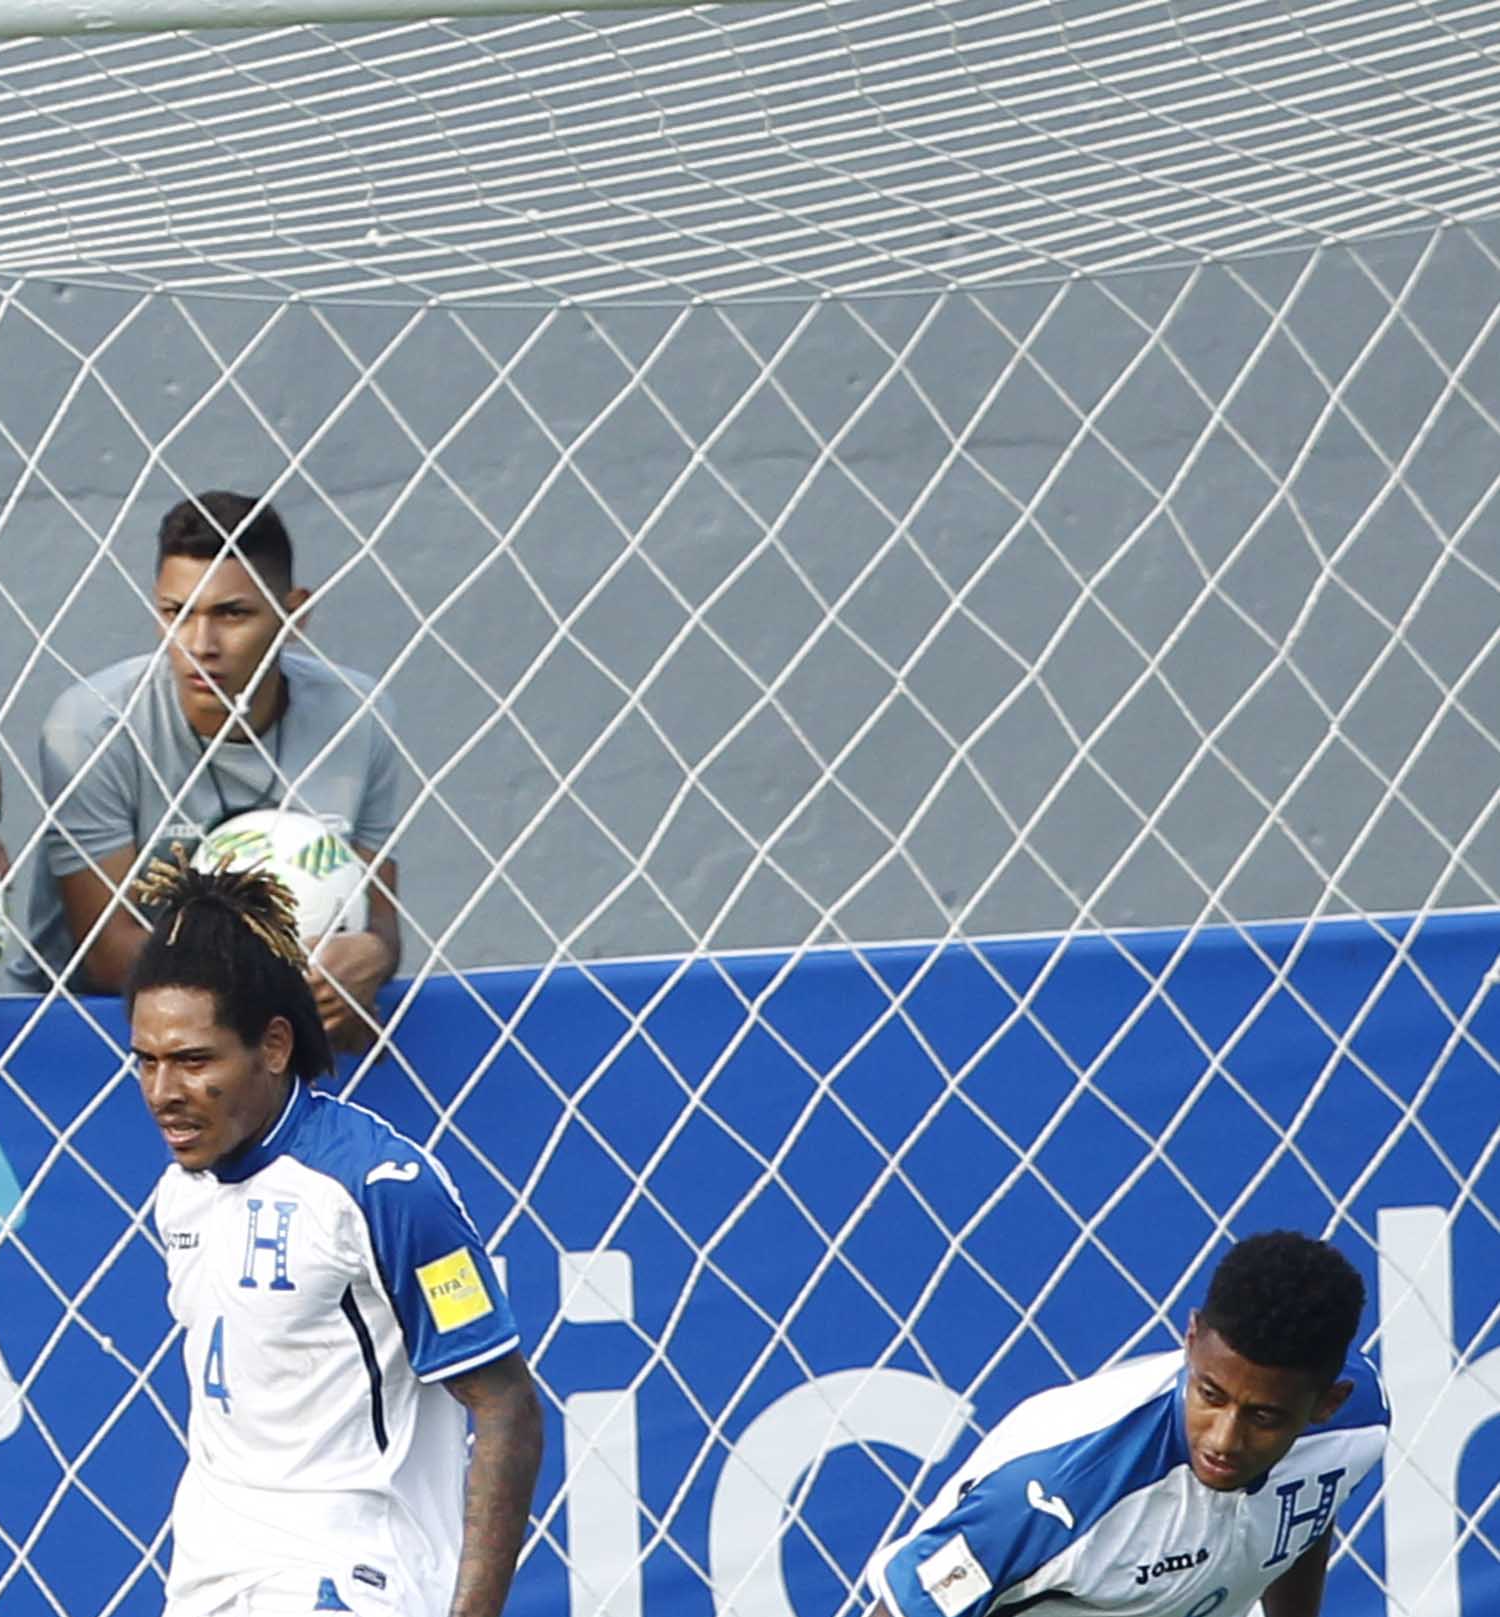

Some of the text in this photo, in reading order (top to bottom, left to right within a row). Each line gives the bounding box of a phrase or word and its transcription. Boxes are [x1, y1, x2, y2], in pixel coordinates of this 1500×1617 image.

[238, 1198, 298, 1291] H
[203, 1314, 232, 1416] 4
[1262, 1468, 1347, 1568] H
